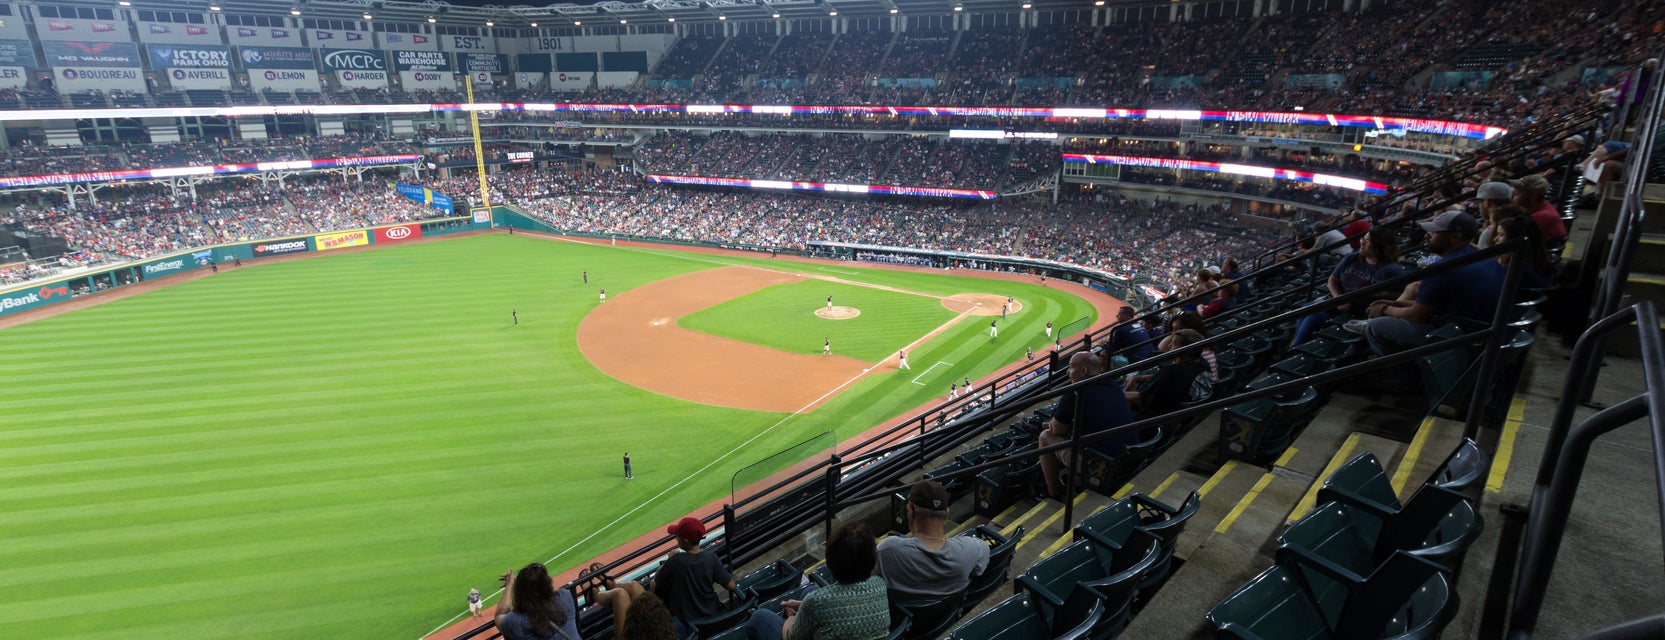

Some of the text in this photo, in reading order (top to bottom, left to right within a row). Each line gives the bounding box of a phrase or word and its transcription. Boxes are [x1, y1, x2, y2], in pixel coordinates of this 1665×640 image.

[453, 36, 485, 49] EST.
[538, 37, 563, 50] 1901
[78, 69, 137, 79] BOUDREAU
[188, 71, 226, 79] AVERILL
[277, 72, 306, 80] LEMON
[424, 73, 441, 81] DOBY
[390, 228, 408, 238] KIA
[145, 259, 184, 273] FirstEnergy
